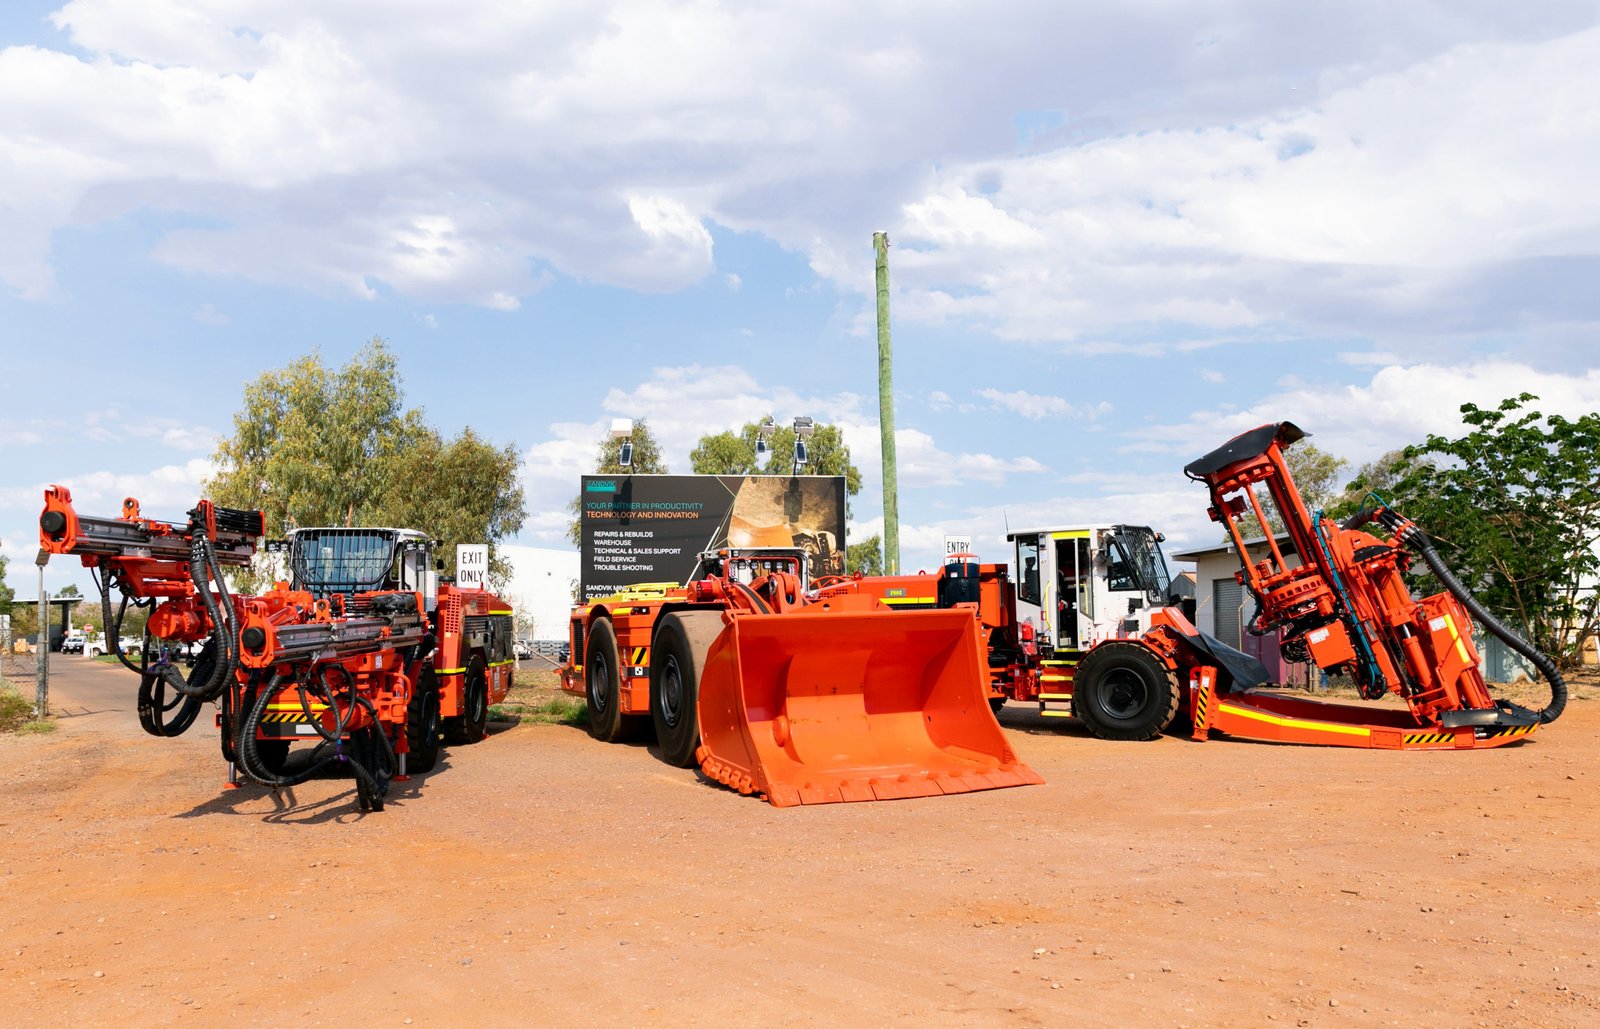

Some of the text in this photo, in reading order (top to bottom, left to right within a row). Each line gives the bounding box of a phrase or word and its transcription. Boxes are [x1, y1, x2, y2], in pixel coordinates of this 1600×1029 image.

[947, 542, 970, 553] ENTRY
[462, 552, 482, 564] EXIT
[461, 570, 484, 582] ONLY
